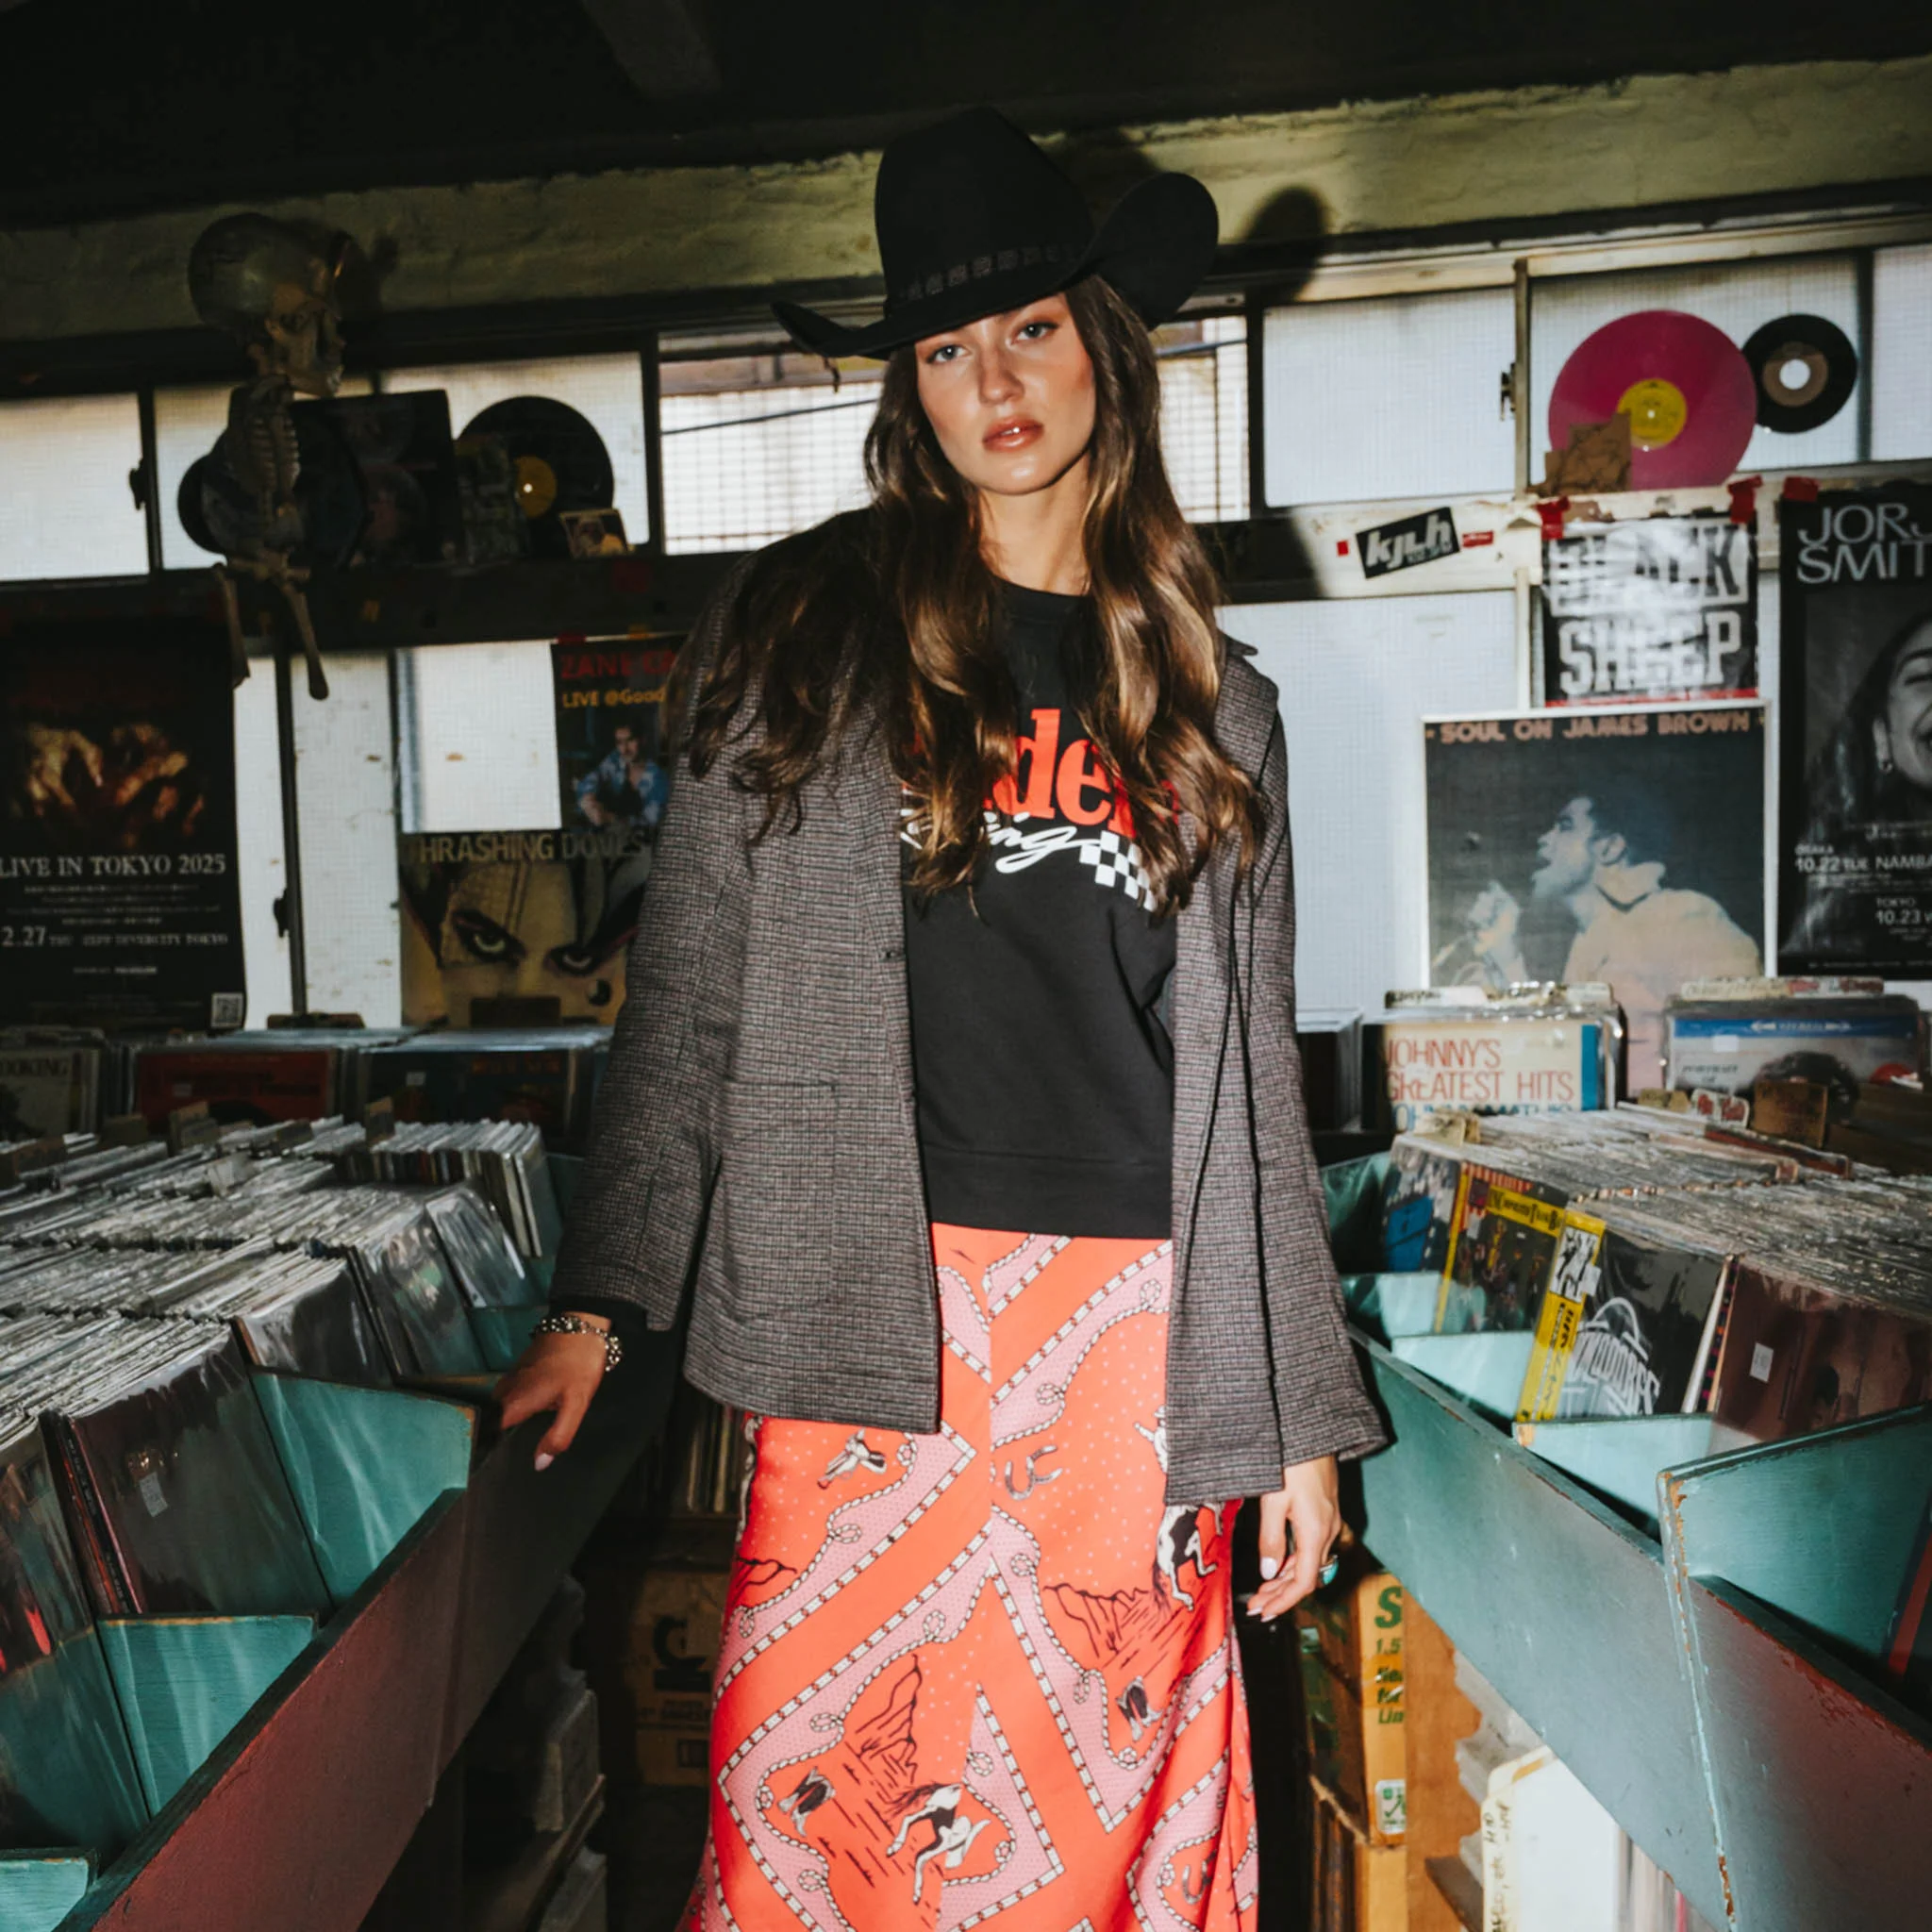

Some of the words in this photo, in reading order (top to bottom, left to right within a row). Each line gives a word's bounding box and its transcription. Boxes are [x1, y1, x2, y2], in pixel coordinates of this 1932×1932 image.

[1796, 502, 1932, 545] JOR
[1441, 722, 1505, 743] SOUL
[1514, 719, 1553, 741] ON
[1563, 715, 1648, 739] JAMES
[1657, 711, 1749, 735] BROWN
[0, 855, 50, 878] LIVE
[57, 856, 83, 876] IN
[90, 854, 172, 876] TOKYO
[178, 853, 226, 874] 2025
[1387, 1038, 1502, 1068] JOHNNY'S
[1516, 1070, 1574, 1102] HITS
